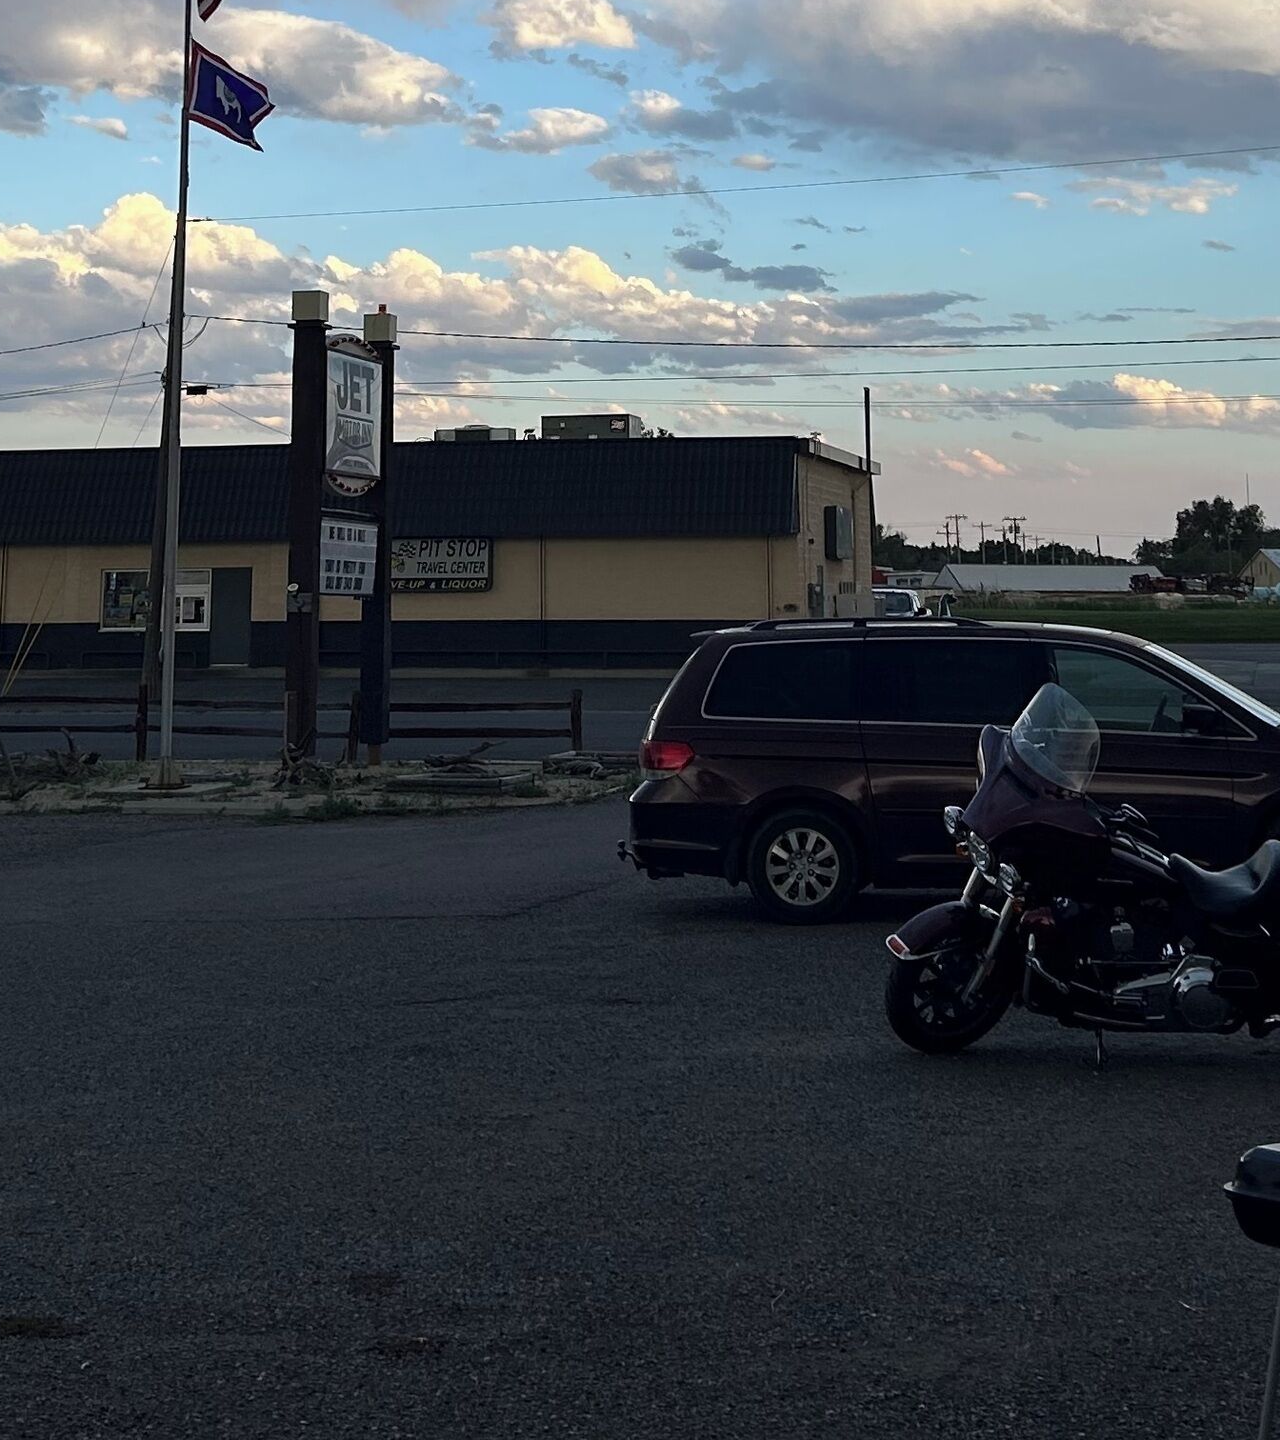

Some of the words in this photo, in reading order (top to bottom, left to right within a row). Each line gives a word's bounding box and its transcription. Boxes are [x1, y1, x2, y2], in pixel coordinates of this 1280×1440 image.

[336, 361, 375, 414] JET
[418, 539, 443, 558] PIT
[446, 539, 488, 558] STOP
[416, 561, 449, 574] TRAVEL
[450, 561, 486, 574] CENTER
[441, 579, 487, 589] LIQUOR
